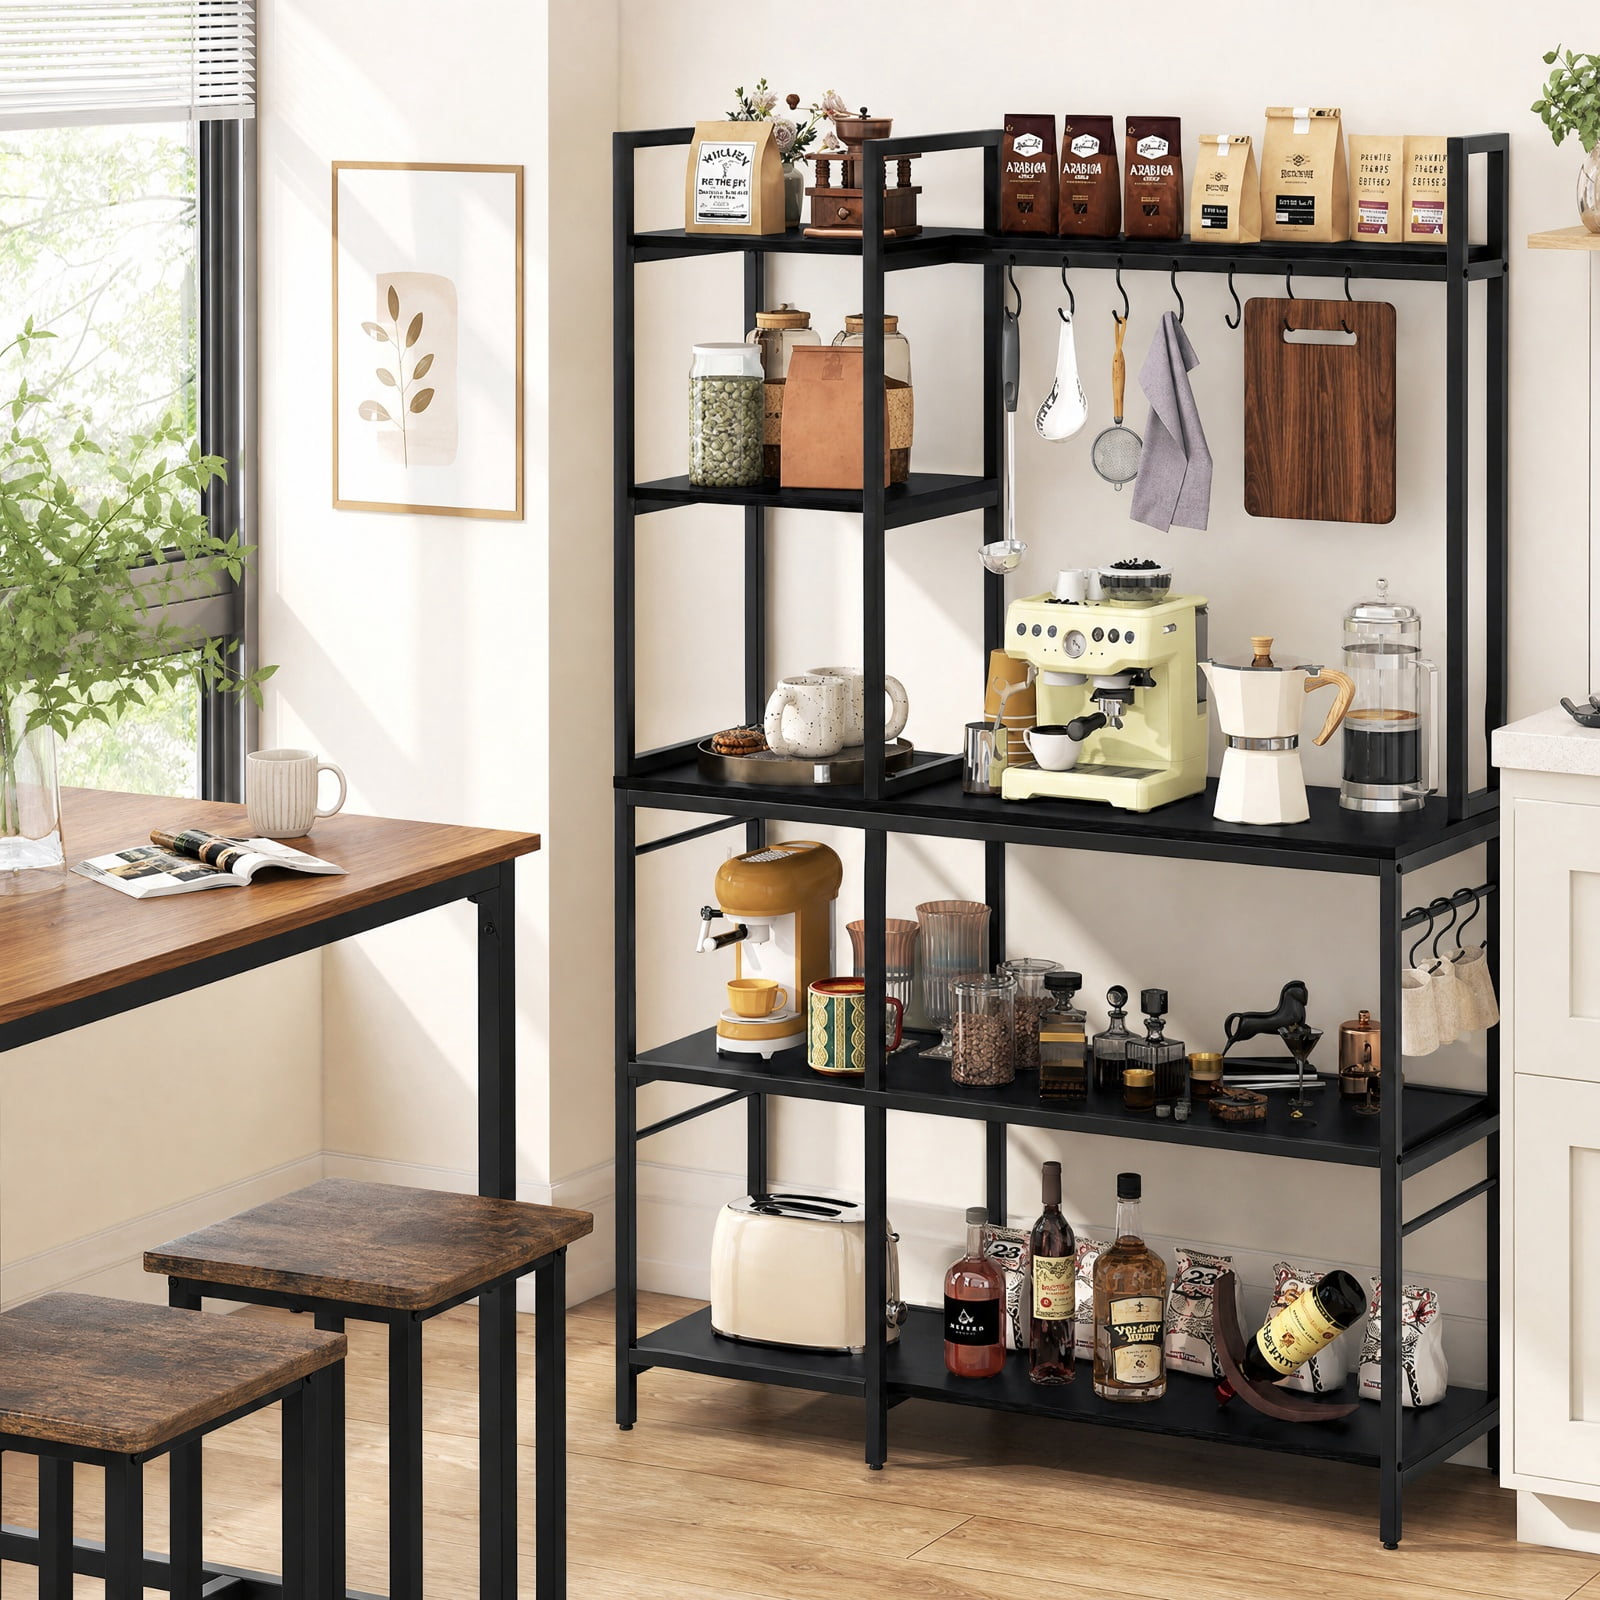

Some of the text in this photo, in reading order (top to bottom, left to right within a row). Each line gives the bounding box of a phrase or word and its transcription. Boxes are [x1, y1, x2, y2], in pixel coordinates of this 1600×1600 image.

[1006, 161, 1047, 174] ARABICA
[1129, 164, 1174, 176] ARABICA
[994, 1244, 1021, 1259] 23
[1187, 1270, 1218, 1285] 23
